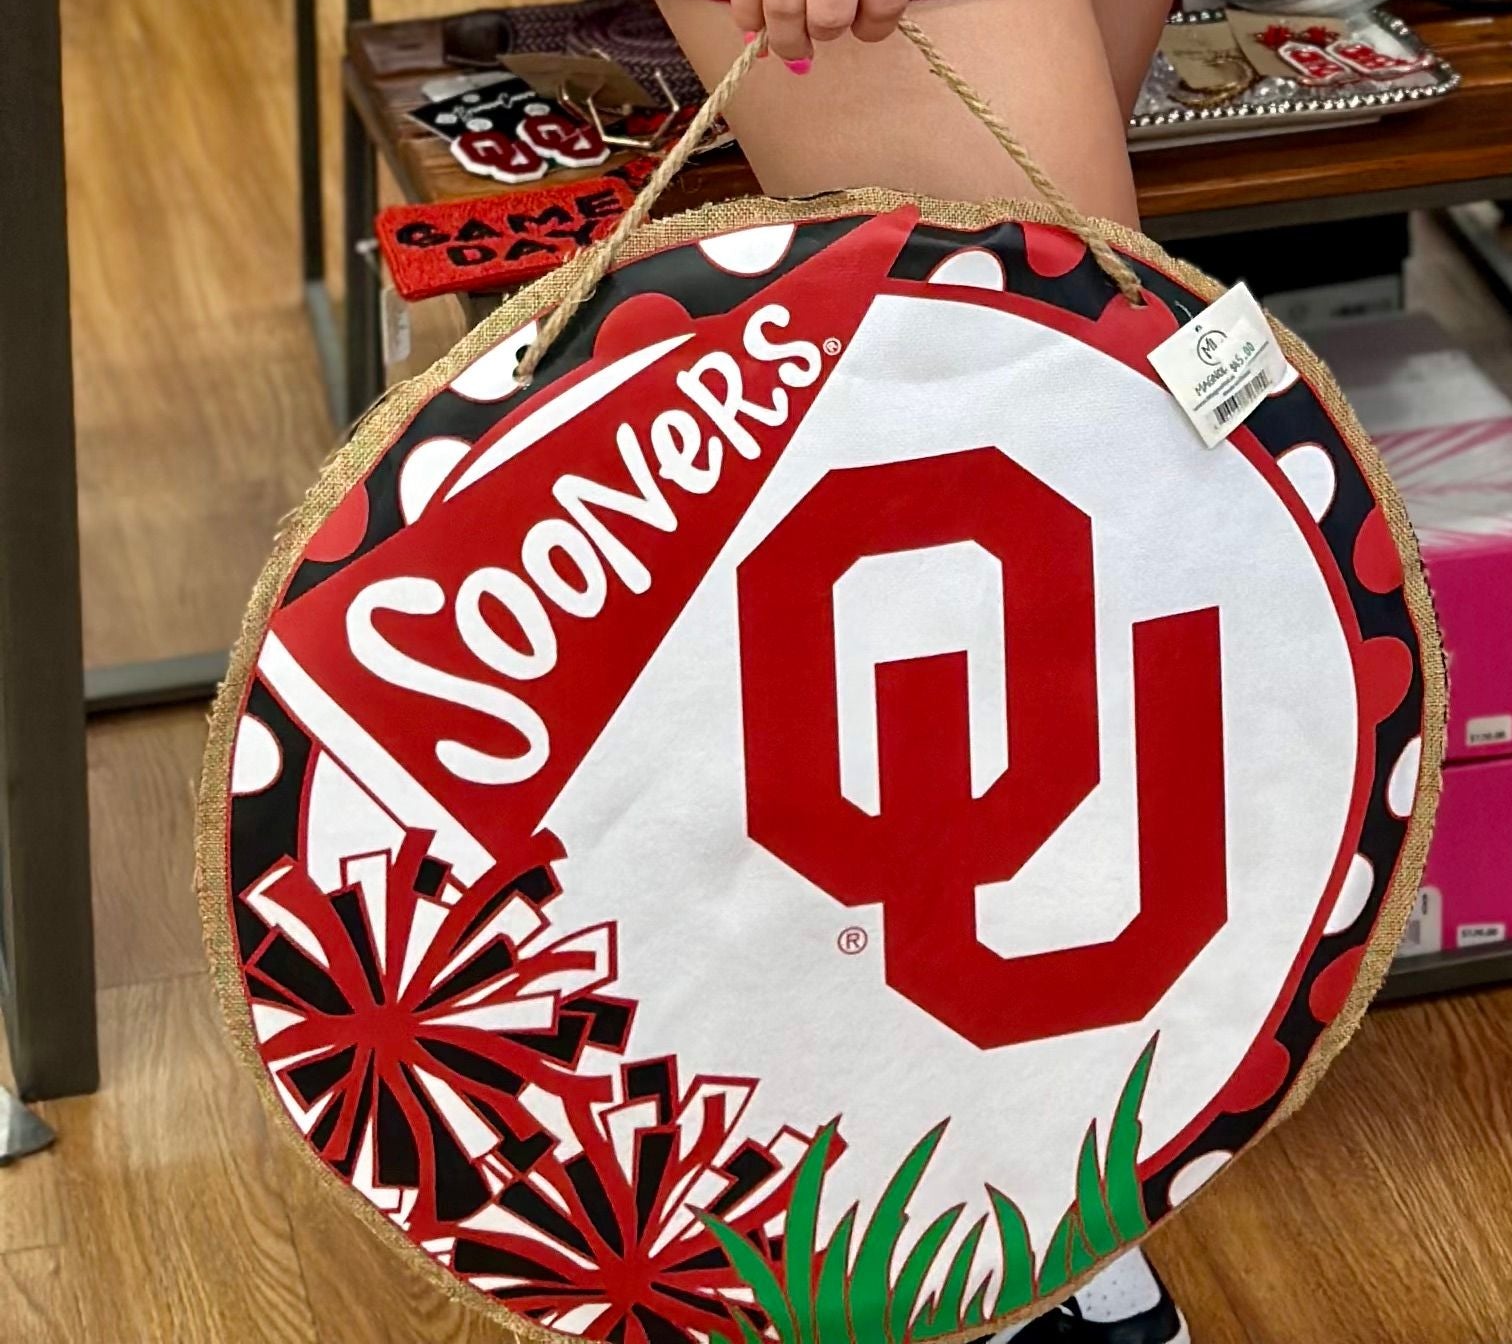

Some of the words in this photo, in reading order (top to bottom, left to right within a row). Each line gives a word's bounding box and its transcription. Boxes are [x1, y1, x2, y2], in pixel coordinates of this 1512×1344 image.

[396, 189, 623, 248] GAME
[445, 217, 604, 268] DAY
[735, 445, 1229, 1050] OU
